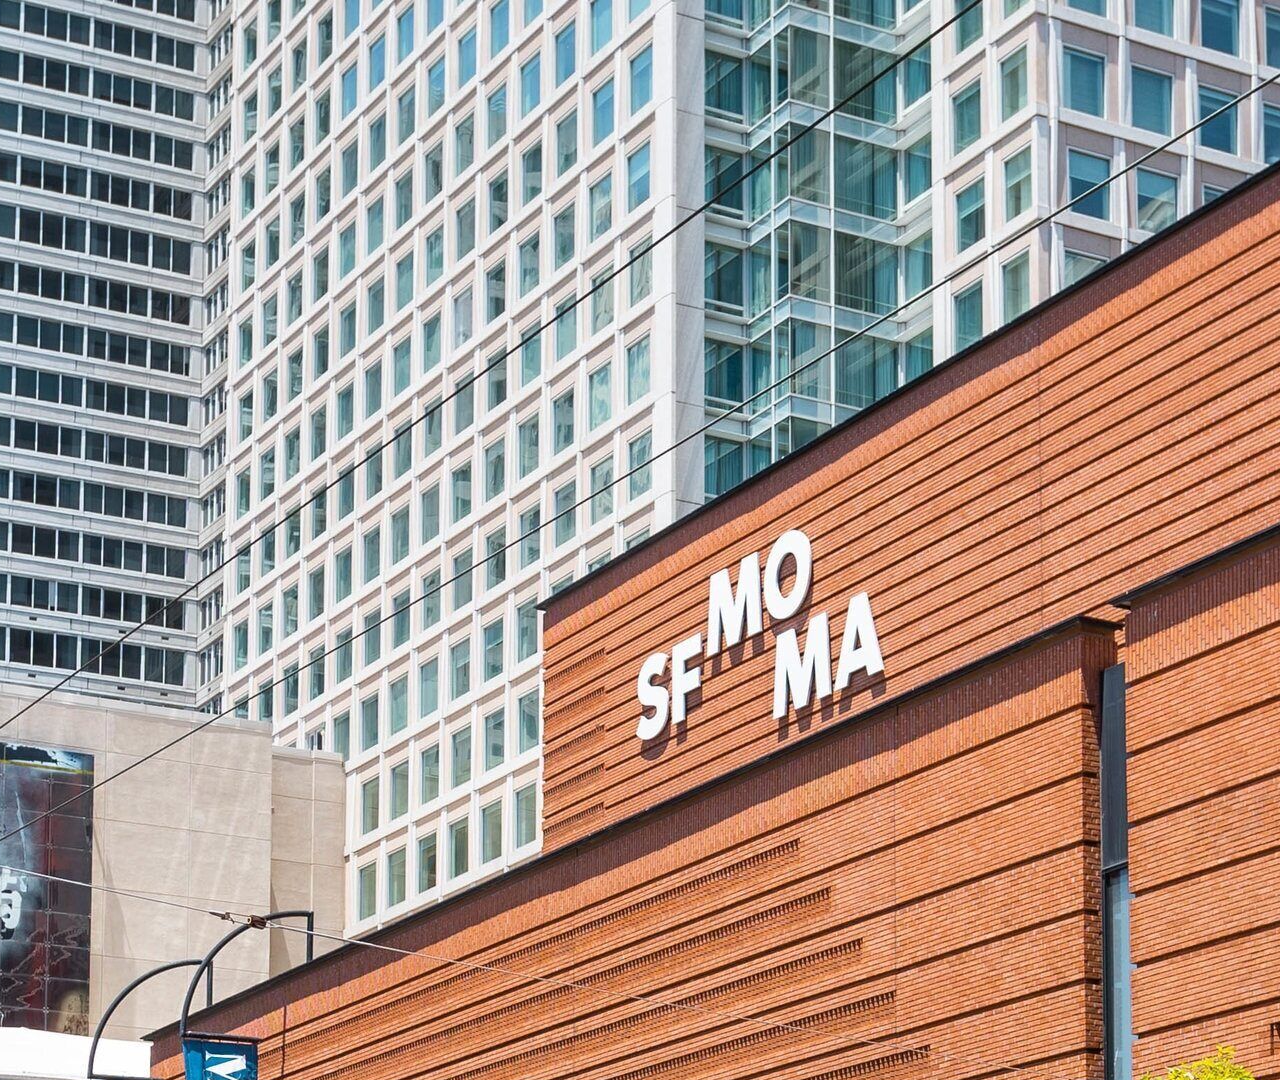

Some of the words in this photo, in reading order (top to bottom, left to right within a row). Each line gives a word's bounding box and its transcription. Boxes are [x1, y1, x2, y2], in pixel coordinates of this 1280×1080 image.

[707, 529, 813, 657] MO
[773, 591, 885, 720] MA
[636, 632, 703, 740] SF
